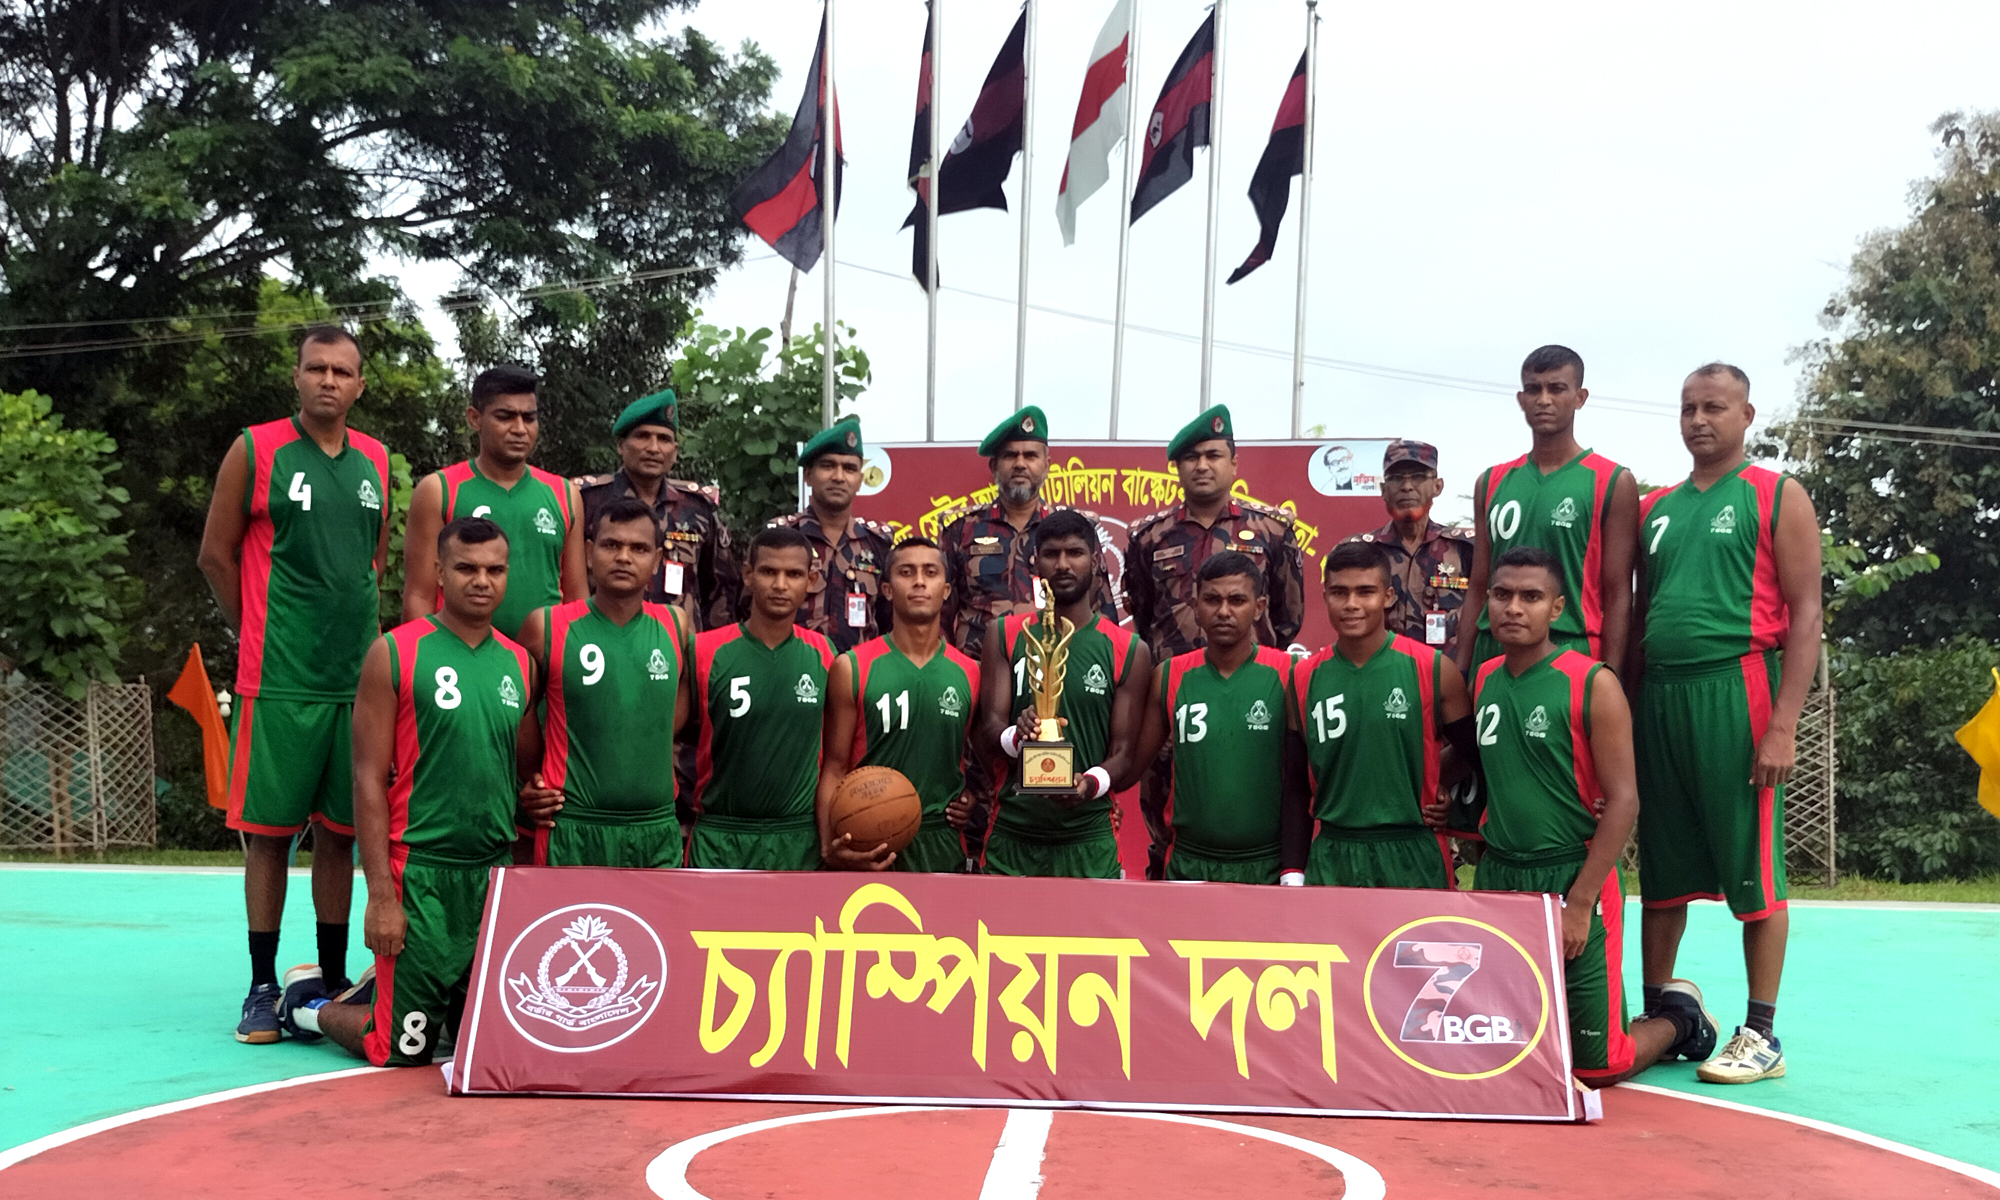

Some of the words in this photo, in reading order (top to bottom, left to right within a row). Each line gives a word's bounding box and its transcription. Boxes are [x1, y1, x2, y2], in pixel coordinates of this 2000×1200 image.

[288, 472, 311, 511] 4
[1489, 500, 1521, 542] 10
[1650, 515, 1670, 555] 7
[579, 643, 605, 686] 9
[434, 666, 462, 710] 8
[729, 675, 751, 718] 5
[875, 689, 910, 734] 11
[1175, 702, 1208, 744] 13
[1311, 693, 1347, 744] 15
[1475, 703, 1500, 746] 12
[690, 883, 1150, 1076] চ্যাম্পিয়ন
[1168, 939, 1350, 1084] দল
[399, 1011, 427, 1055] 8
[1443, 1014, 1515, 1042] BGB
